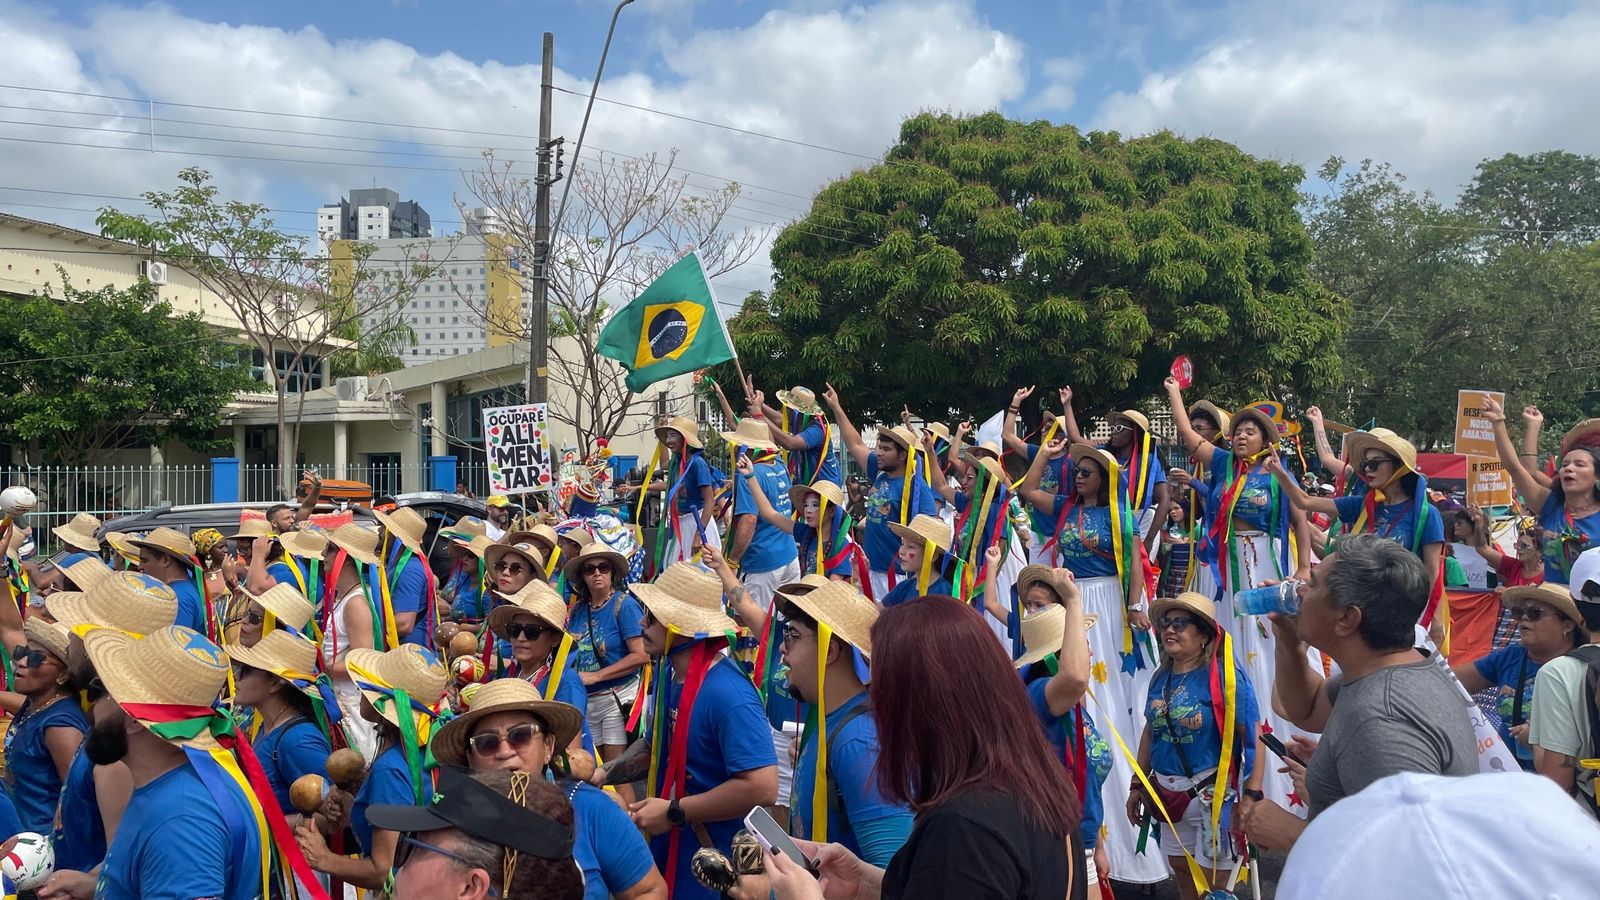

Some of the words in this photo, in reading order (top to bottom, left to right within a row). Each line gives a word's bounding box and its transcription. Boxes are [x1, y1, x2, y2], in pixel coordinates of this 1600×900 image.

[501, 423, 534, 446] ALI
[1470, 418, 1493, 430] NOSSA
[496, 444, 543, 468] MEN
[501, 466, 541, 489] TAR
[1480, 472, 1501, 481] NOSSA
